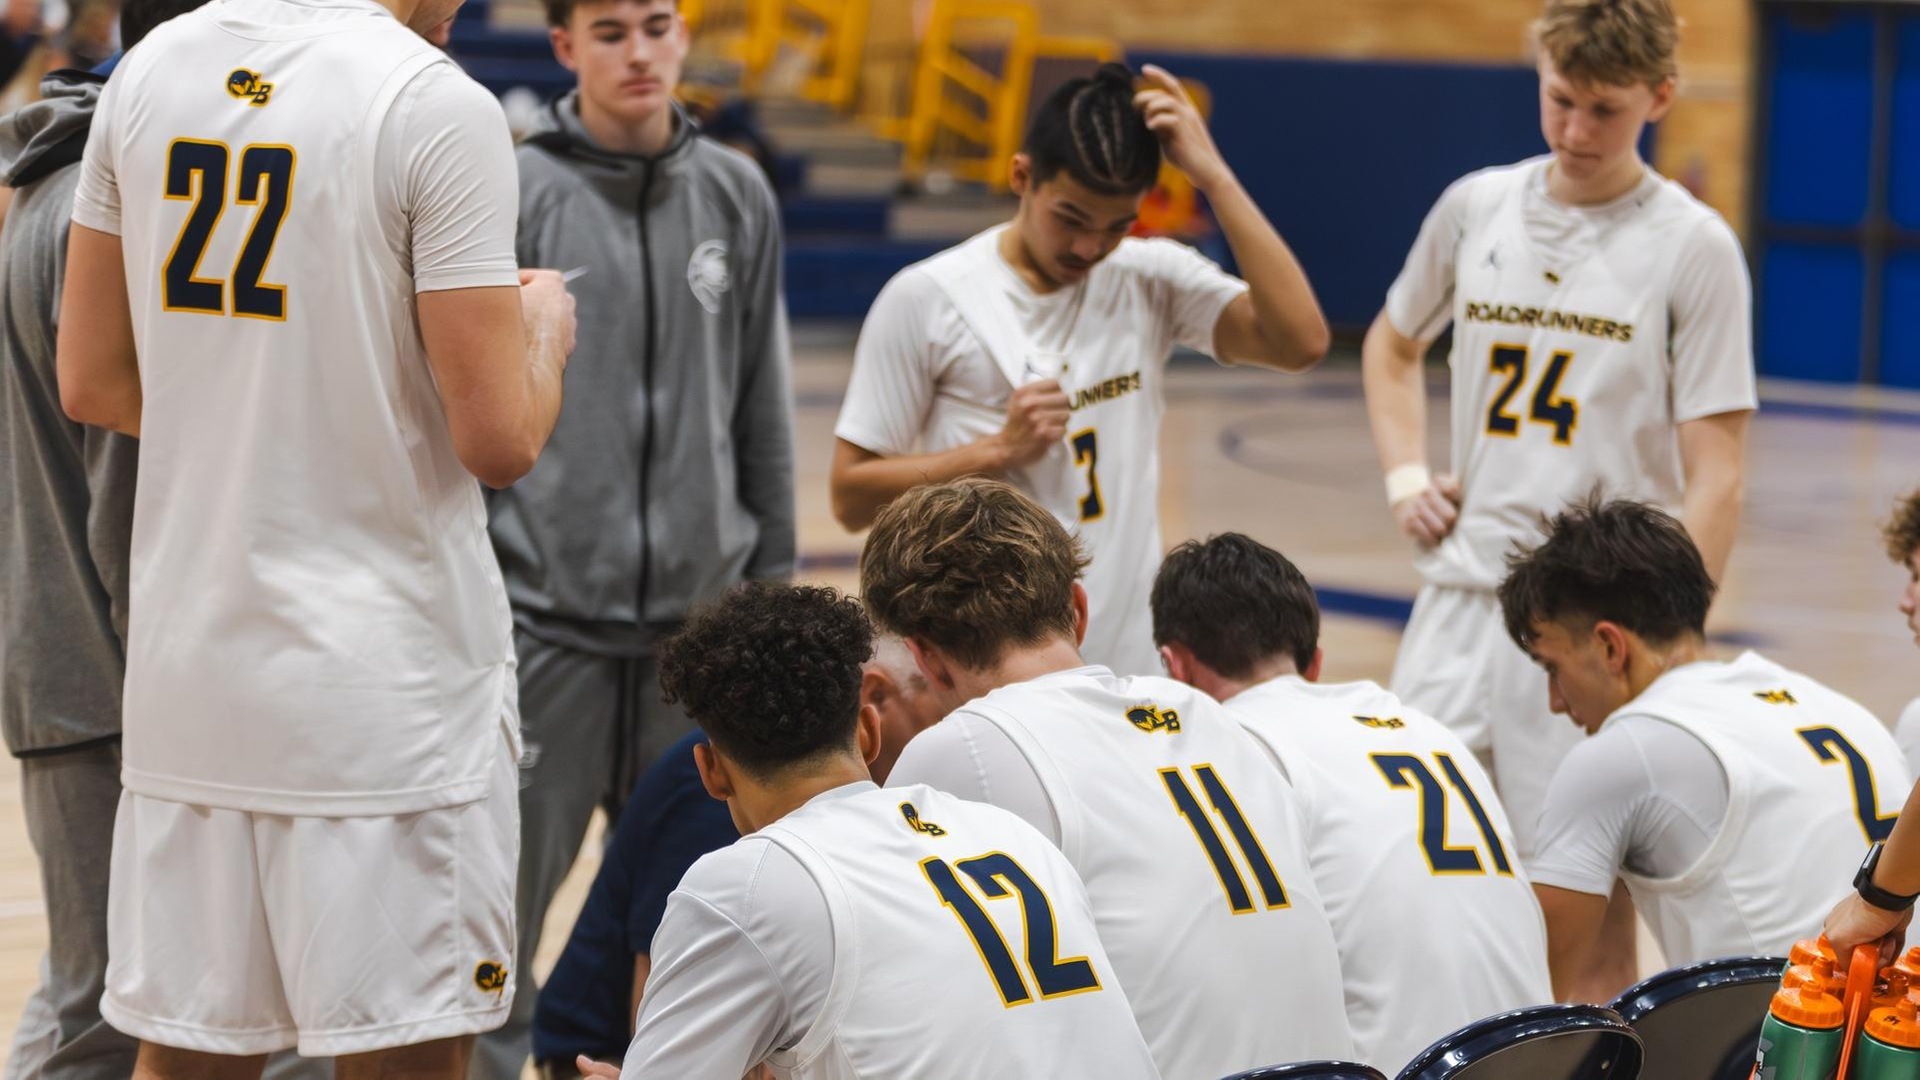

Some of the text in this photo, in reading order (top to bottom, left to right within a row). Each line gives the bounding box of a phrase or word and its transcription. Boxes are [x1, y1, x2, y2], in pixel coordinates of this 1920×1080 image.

[161, 137, 297, 321] 22
[1466, 303, 1635, 342] ROADRUNNERS
[1067, 371, 1142, 411] UNNERS
[1486, 342, 1579, 446] 24
[1157, 763, 1292, 916] 11
[1368, 752, 1515, 879] 21
[1795, 726, 1901, 847] 2
[918, 851, 1103, 1009] 12
